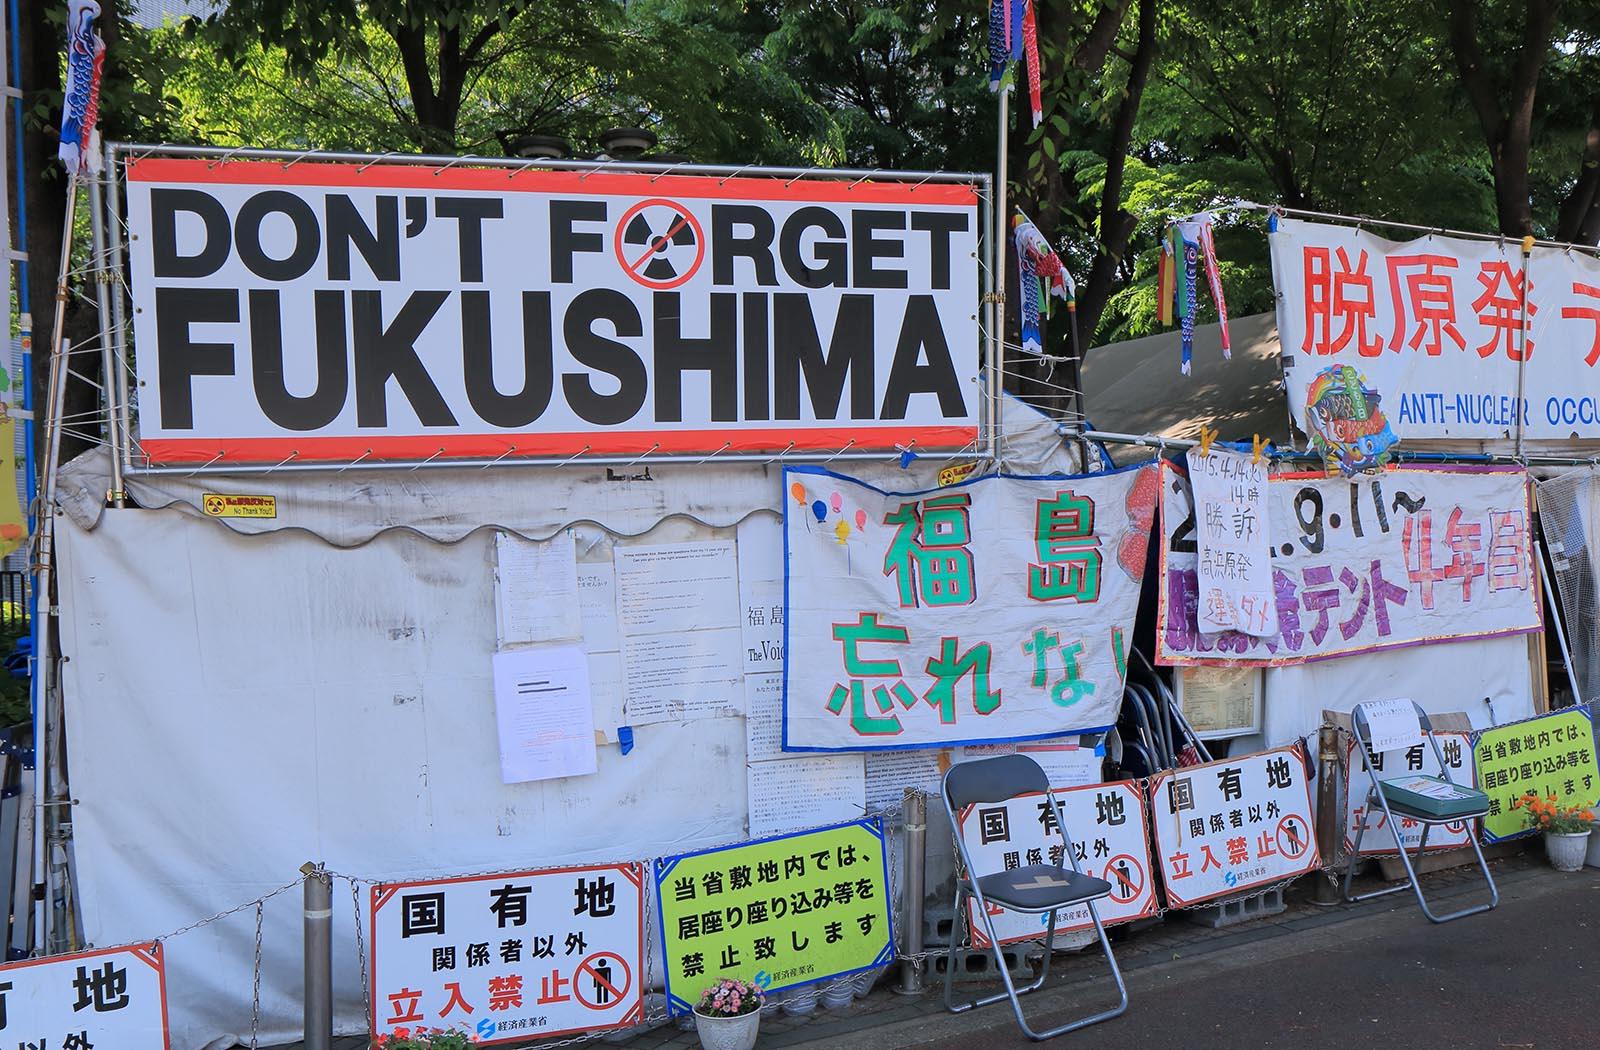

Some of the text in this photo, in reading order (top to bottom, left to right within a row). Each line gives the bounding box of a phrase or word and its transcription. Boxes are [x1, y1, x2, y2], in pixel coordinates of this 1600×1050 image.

[150, 188, 503, 284] DON'T
[156, 287, 969, 431] FUKUSHIMA
[883, 490, 1103, 609] 福島
[748, 605, 784, 626] 福島
[748, 648, 762, 662] The
[1166, 756, 1292, 815] 国有地
[1484, 748, 1591, 790] 居座り座り込み等を
[979, 791, 1126, 846] 国有地
[1189, 802, 1281, 839] 関係者以外
[674, 844, 871, 903] 当省敷地内では、
[1169, 830, 1277, 881] 立入禁止
[402, 876, 615, 939] 国有地
[677, 878, 875, 941] 居座り座り込み等を
[431, 931, 588, 973] 関係者以外
[682, 912, 876, 979] 禁止致します
[387, 969, 571, 1025] 立入禁止
[773, 964, 816, 985] 経済産業省
[497, 1014, 548, 1034] 経済産業省
